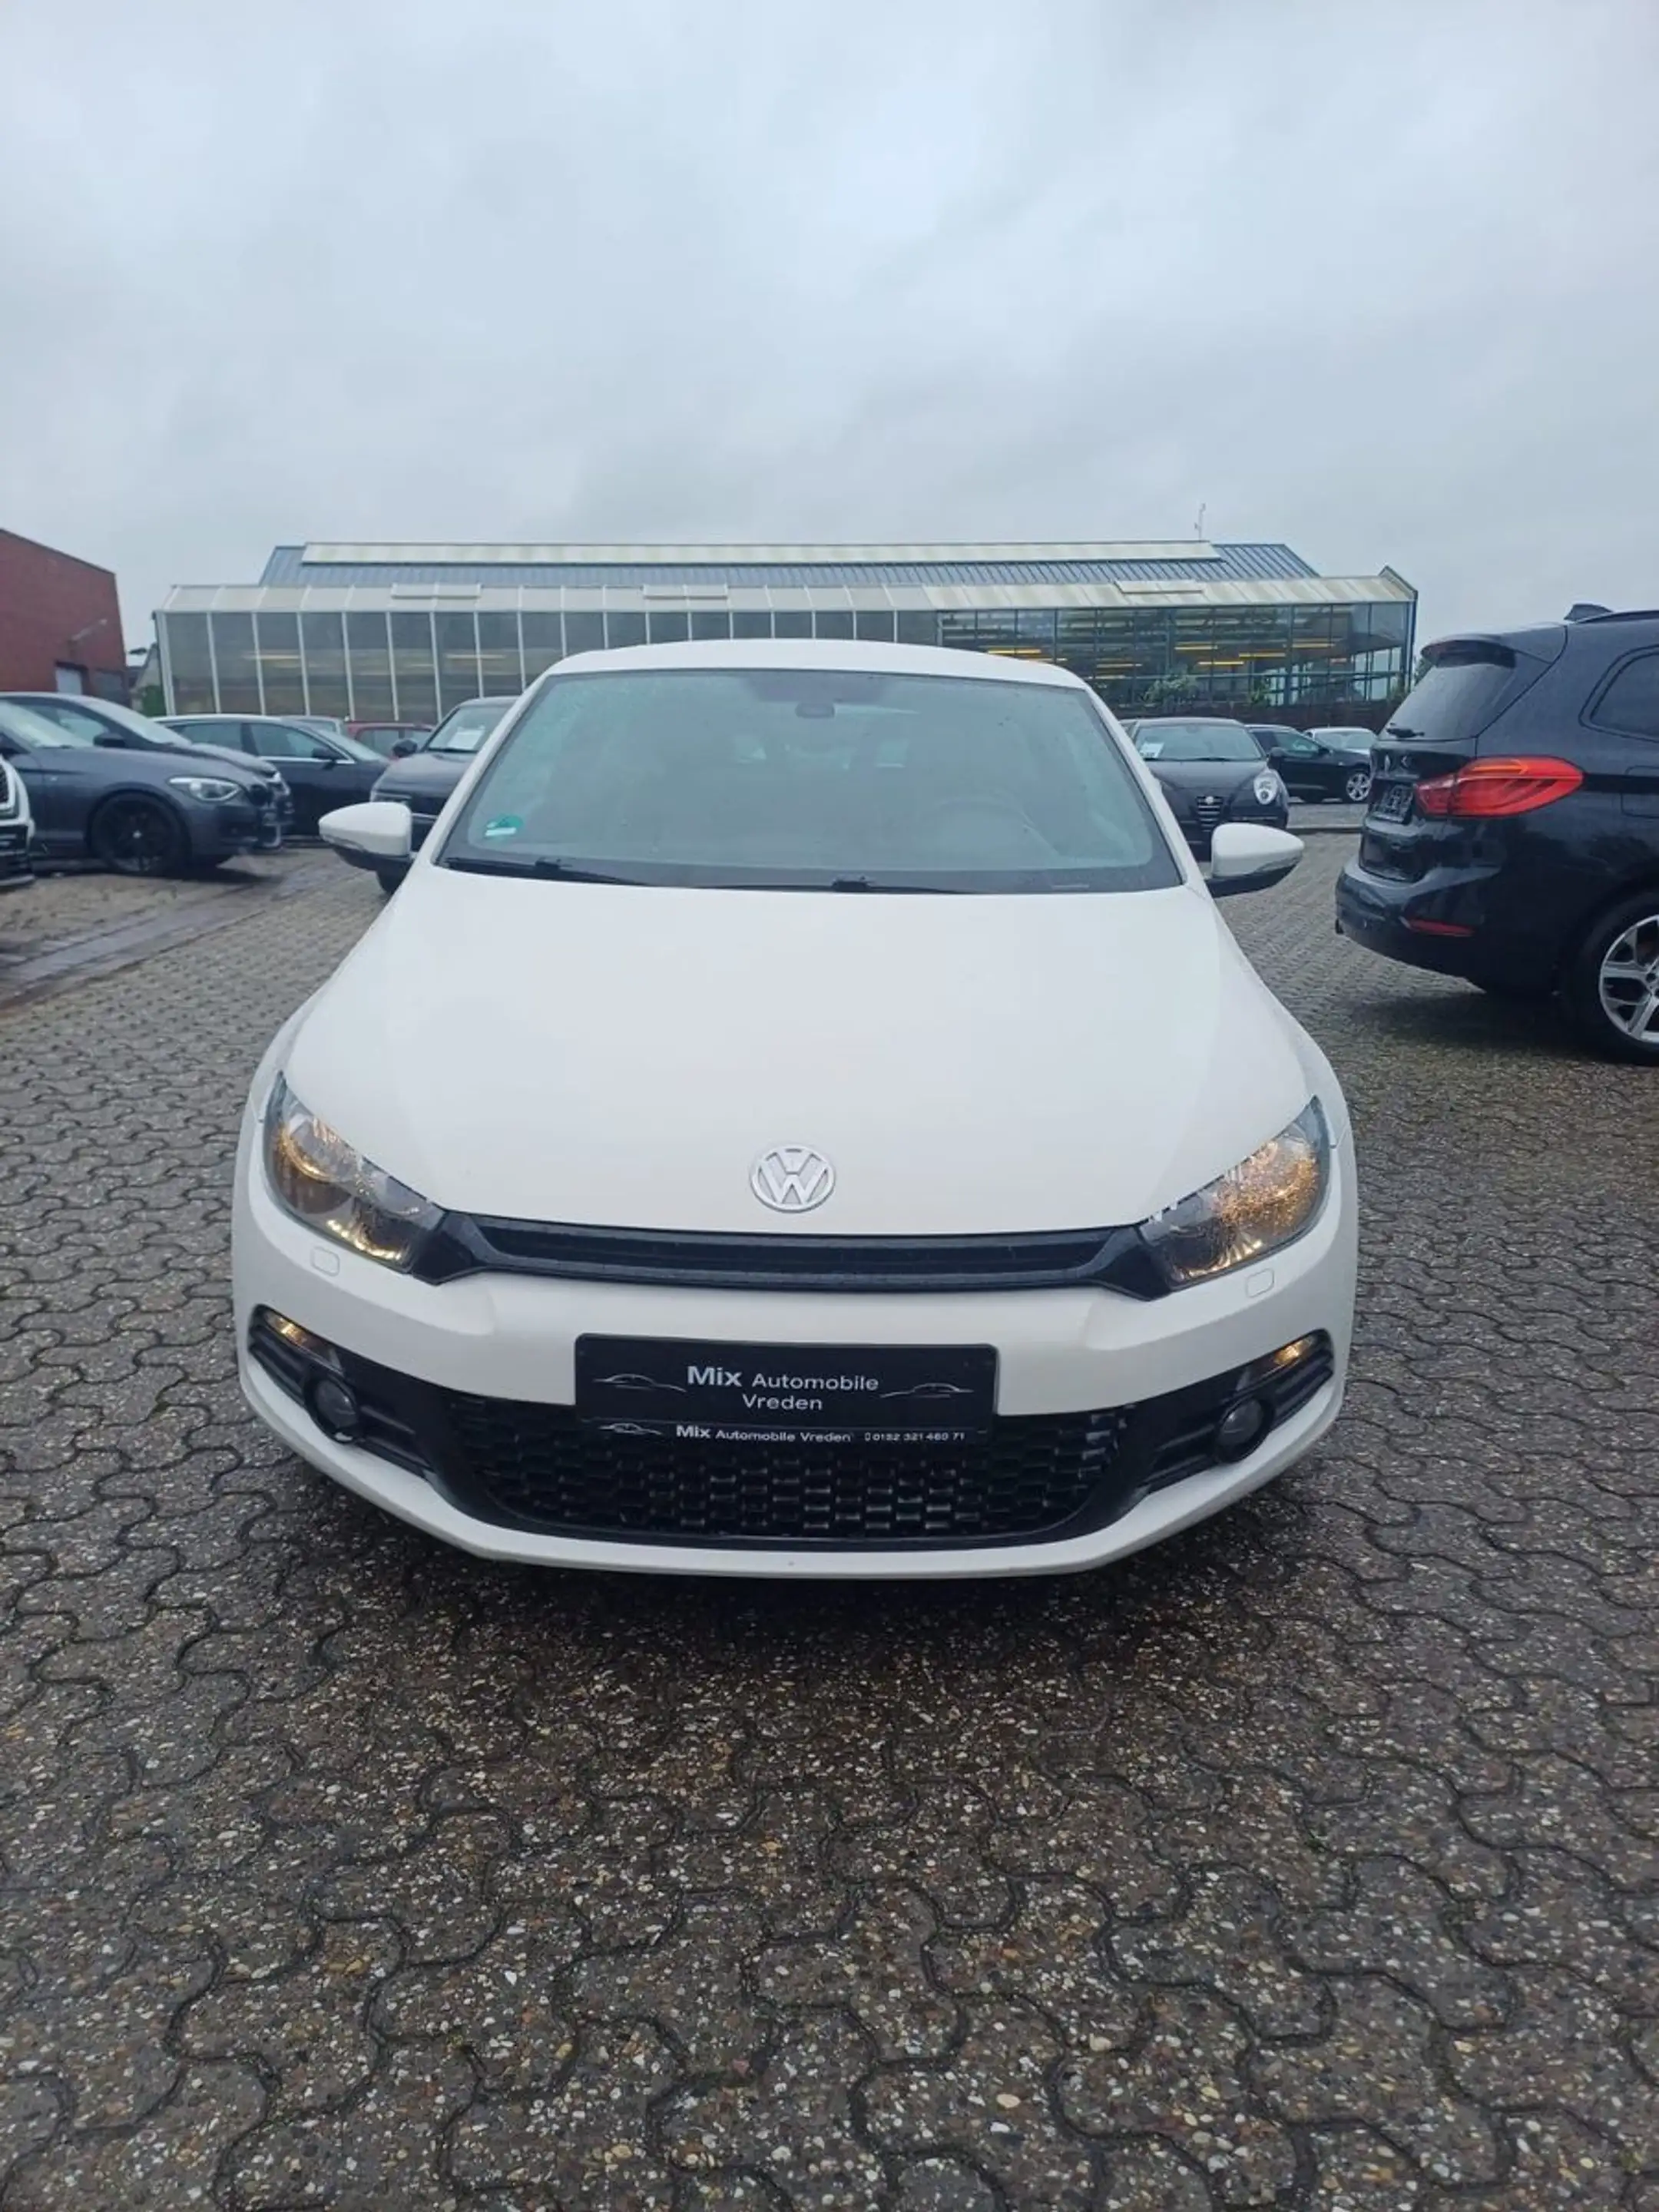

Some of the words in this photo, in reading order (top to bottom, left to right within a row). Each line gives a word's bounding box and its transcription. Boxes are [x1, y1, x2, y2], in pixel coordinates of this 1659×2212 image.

[687, 1366, 743, 1387] Mix
[752, 1373, 879, 1391] Automobile
[742, 1393, 823, 1411] Vreden
[676, 1425, 710, 1439] Mix
[715, 1429, 796, 1442] Automobile
[800, 1432, 851, 1443] Vreden
